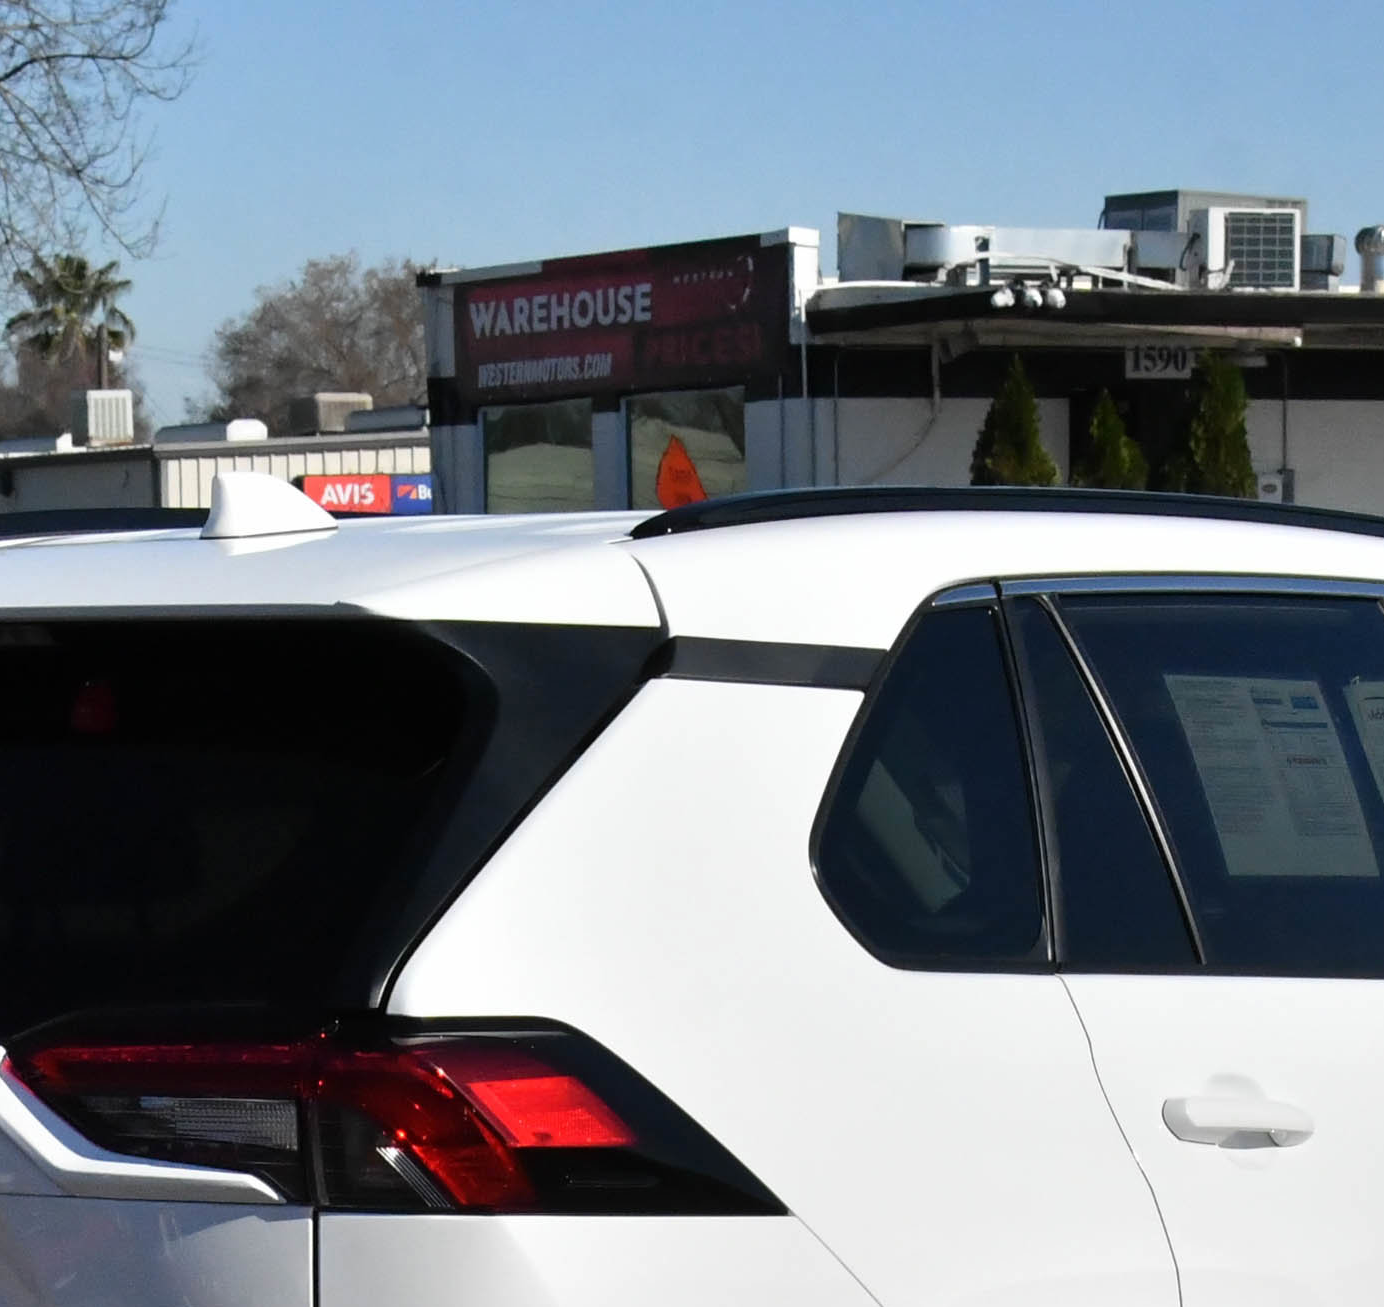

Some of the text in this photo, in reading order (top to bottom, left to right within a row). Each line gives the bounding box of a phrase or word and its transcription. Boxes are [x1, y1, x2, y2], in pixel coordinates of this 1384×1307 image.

[469, 282, 653, 339] WAREHOUSE
[478, 352, 613, 388] WESTERNMOTORS.COM
[1131, 345, 1188, 373] 1590
[320, 483, 376, 505] AVIS
